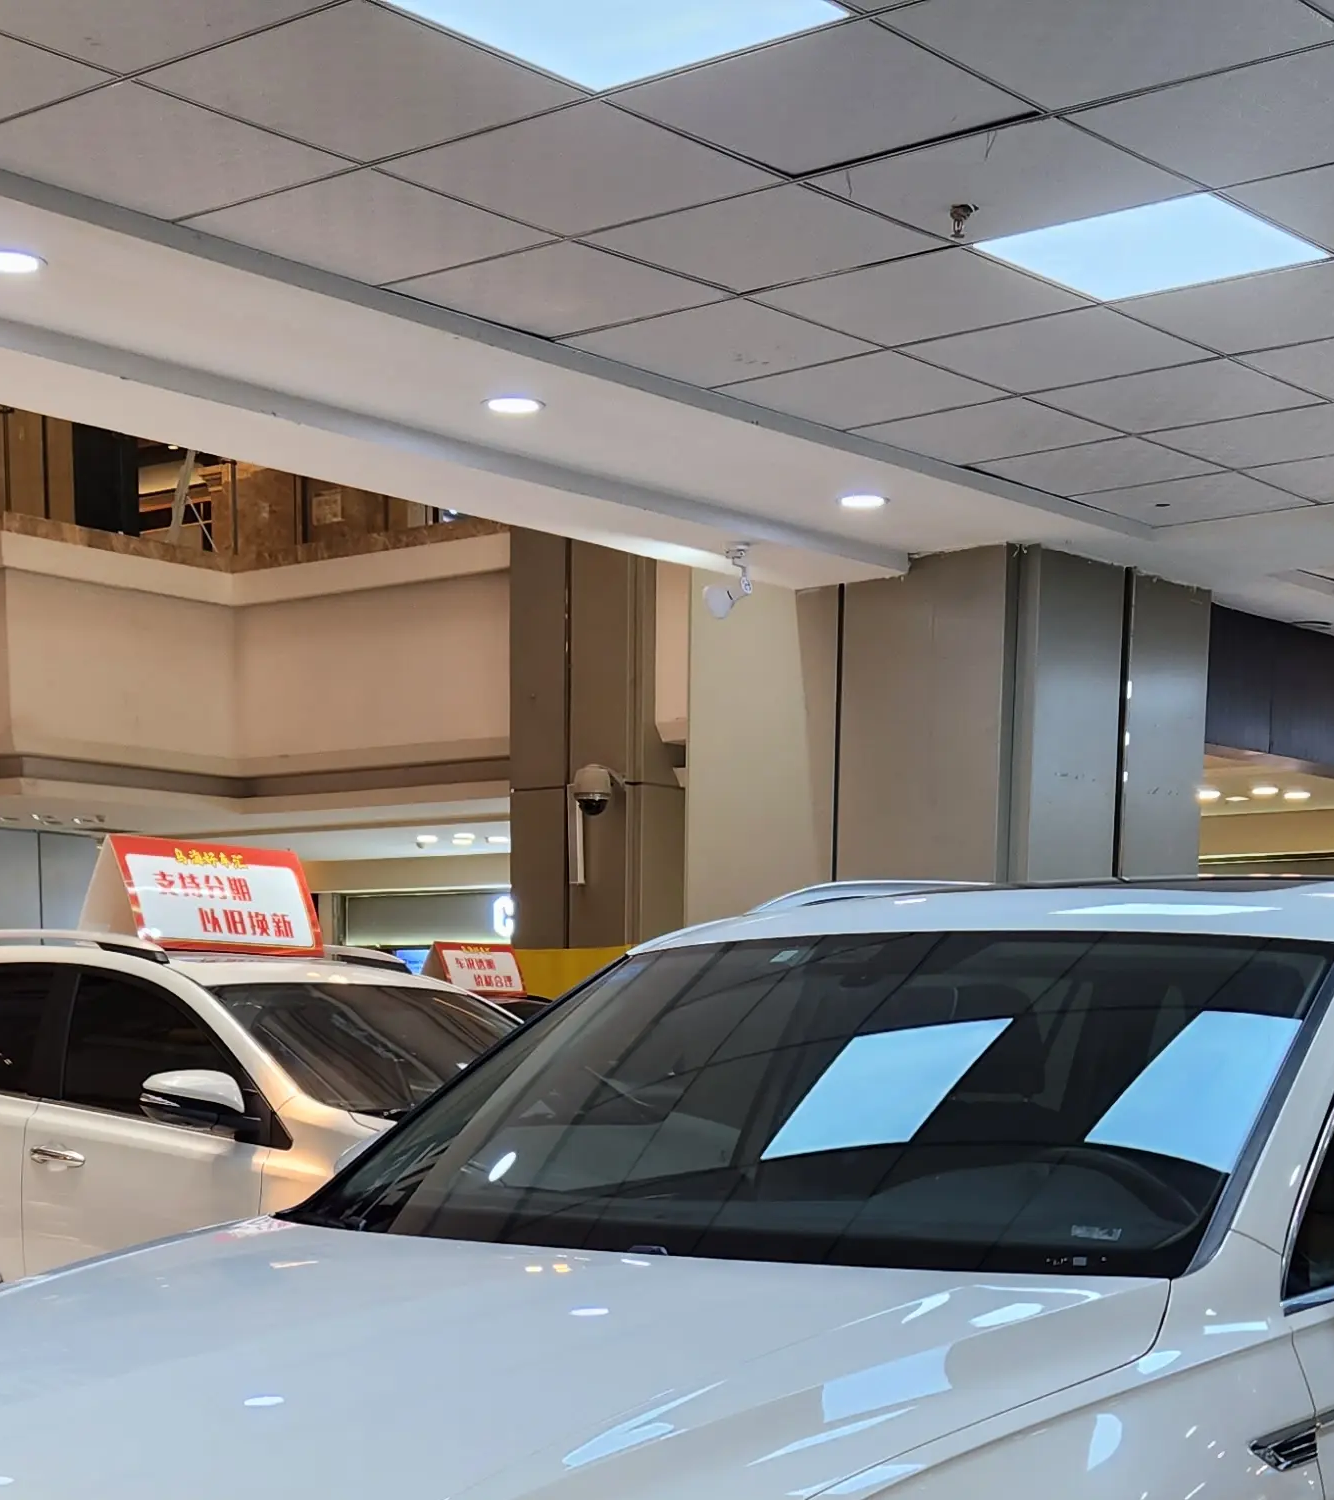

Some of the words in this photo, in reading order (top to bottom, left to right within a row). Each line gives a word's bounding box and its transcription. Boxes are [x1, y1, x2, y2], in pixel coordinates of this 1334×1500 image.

[174, 847, 249, 869] 乌海好车汇
[152, 871, 252, 902] 支持分期
[198, 907, 295, 939] 以旧换新
